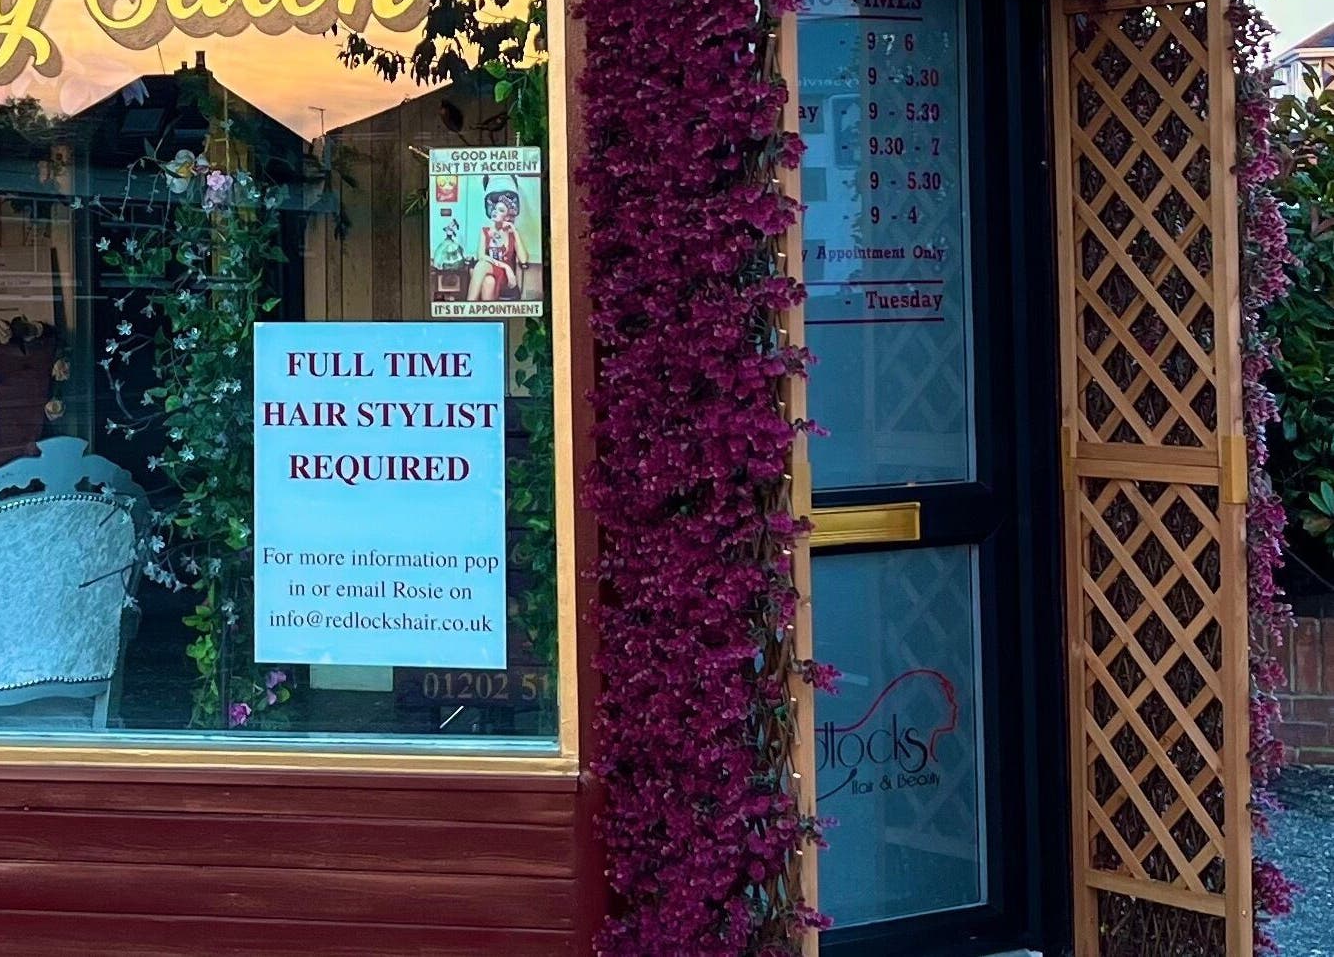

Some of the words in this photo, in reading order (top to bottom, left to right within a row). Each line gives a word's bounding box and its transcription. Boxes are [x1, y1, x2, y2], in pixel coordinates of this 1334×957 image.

[867, 32, 877, 51] 9
[904, 33, 915, 52] 6
[868, 67, 878, 86] 9
[868, 102, 879, 121] 9
[906, 103, 941, 122] 5.30
[451, 150, 487, 161] GOOD
[490, 150, 519, 161] HAIR
[869, 136, 905, 156] 9.30
[431, 162, 461, 173] ISN'T
[463, 162, 478, 173] BY
[481, 161, 538, 173] ACCIDENT
[870, 171, 880, 190] 9
[907, 171, 942, 190] 5.30
[870, 206, 881, 225] 9
[908, 205, 918, 224] 4
[816, 245, 906, 262] Appointment
[913, 245, 945, 261] Only
[434, 305, 451, 315] IT'S
[453, 305, 466, 315] BY
[468, 305, 540, 315] APPOINTMENT
[866, 290, 944, 311] Tuesday
[286, 352, 375, 377] FULL
[384, 352, 473, 378] TIME
[262, 402, 349, 427] HAIR
[357, 402, 498, 429] STYLIST
[289, 454, 471, 485] REQUIRED
[263, 547, 294, 565] For
[299, 553, 345, 566] more
[351, 549, 458, 569] information
[465, 555, 499, 574] pop
[289, 580, 305, 596] in
[311, 585, 331, 597] or
[336, 581, 386, 598] email
[393, 581, 443, 599] Rosie
[449, 587, 472, 600] on
[269, 610, 493, 632] info@redlockshair.co.uk
[423, 672, 509, 700] 01202
[814, 713, 928, 774] dlocks
[879, 775, 892, 790] &
